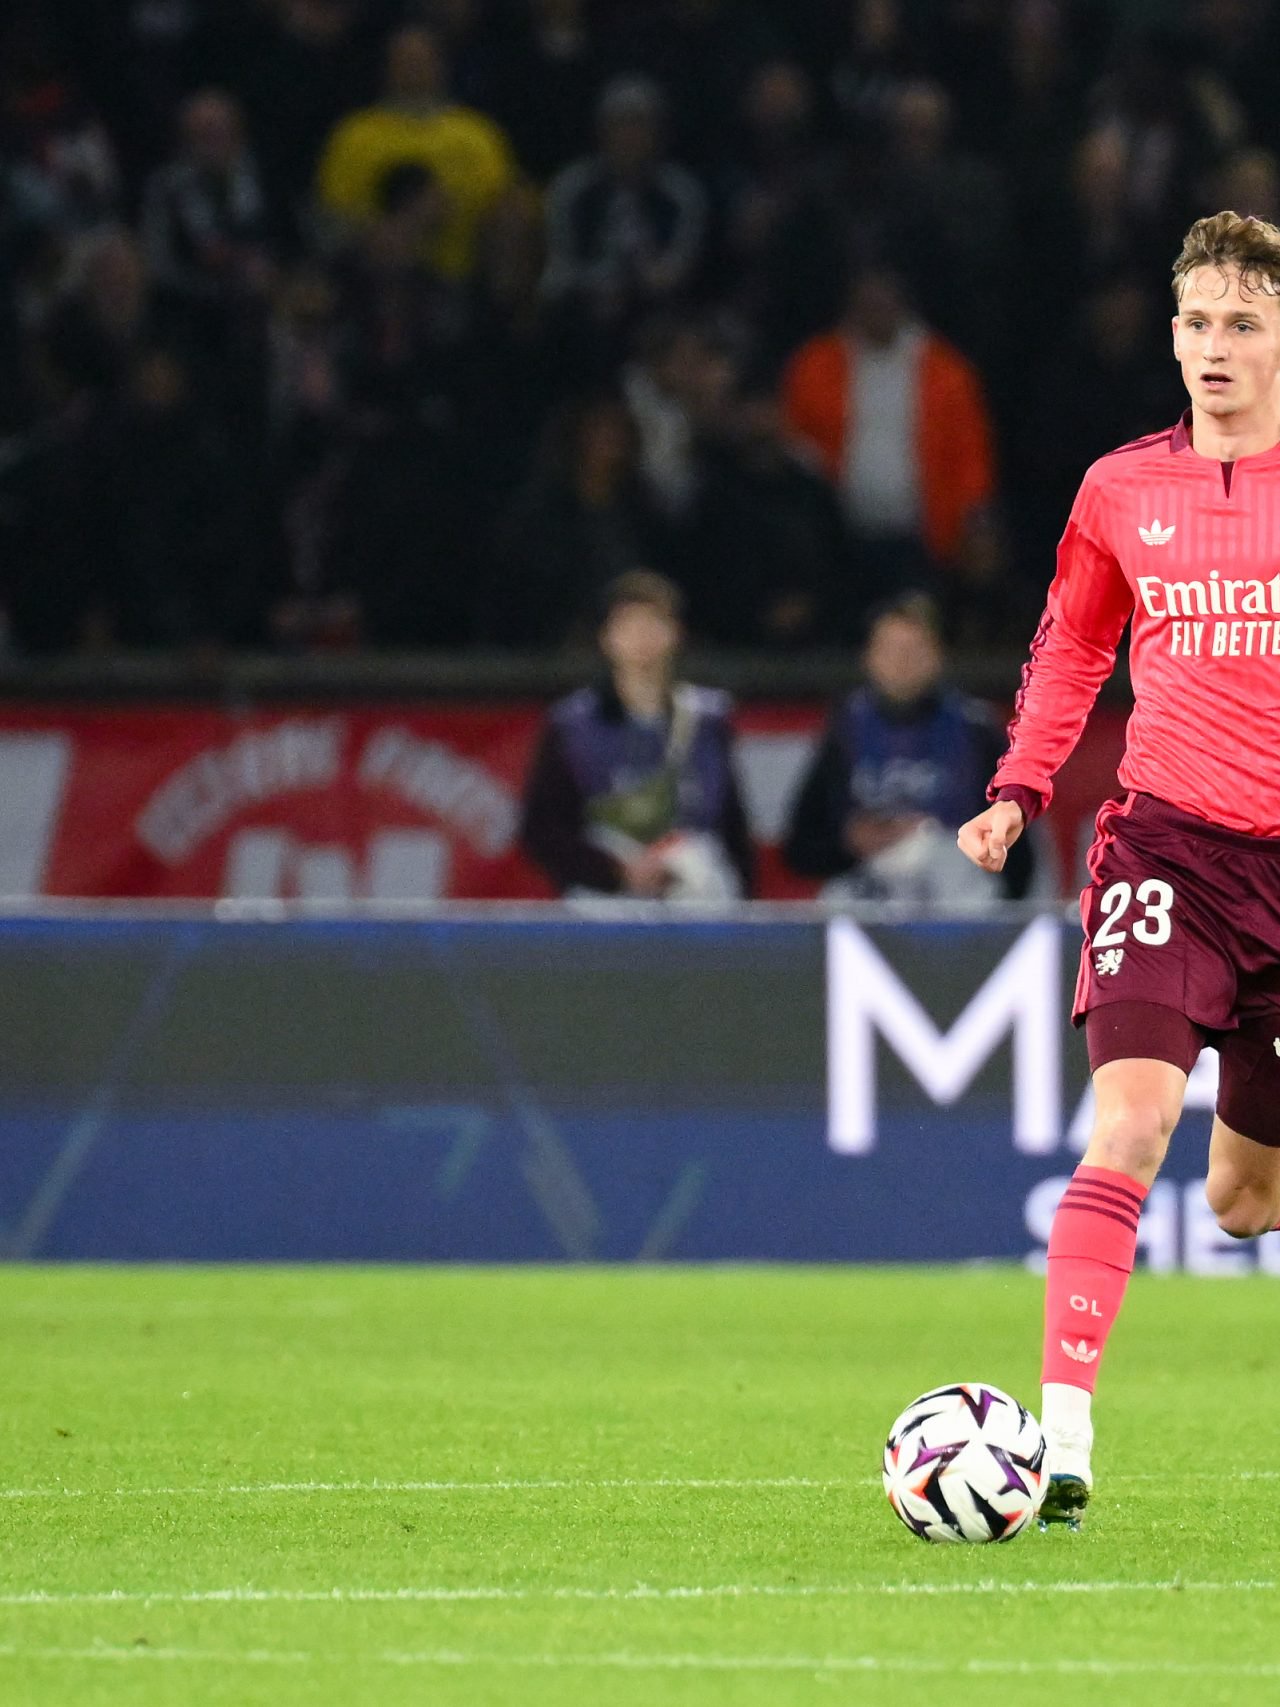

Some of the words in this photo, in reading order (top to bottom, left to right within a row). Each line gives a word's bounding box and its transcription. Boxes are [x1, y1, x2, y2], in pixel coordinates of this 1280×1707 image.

[1170, 621, 1204, 656] FLY
[1091, 878, 1174, 948] 23
[1069, 1294, 1103, 1318] OL
